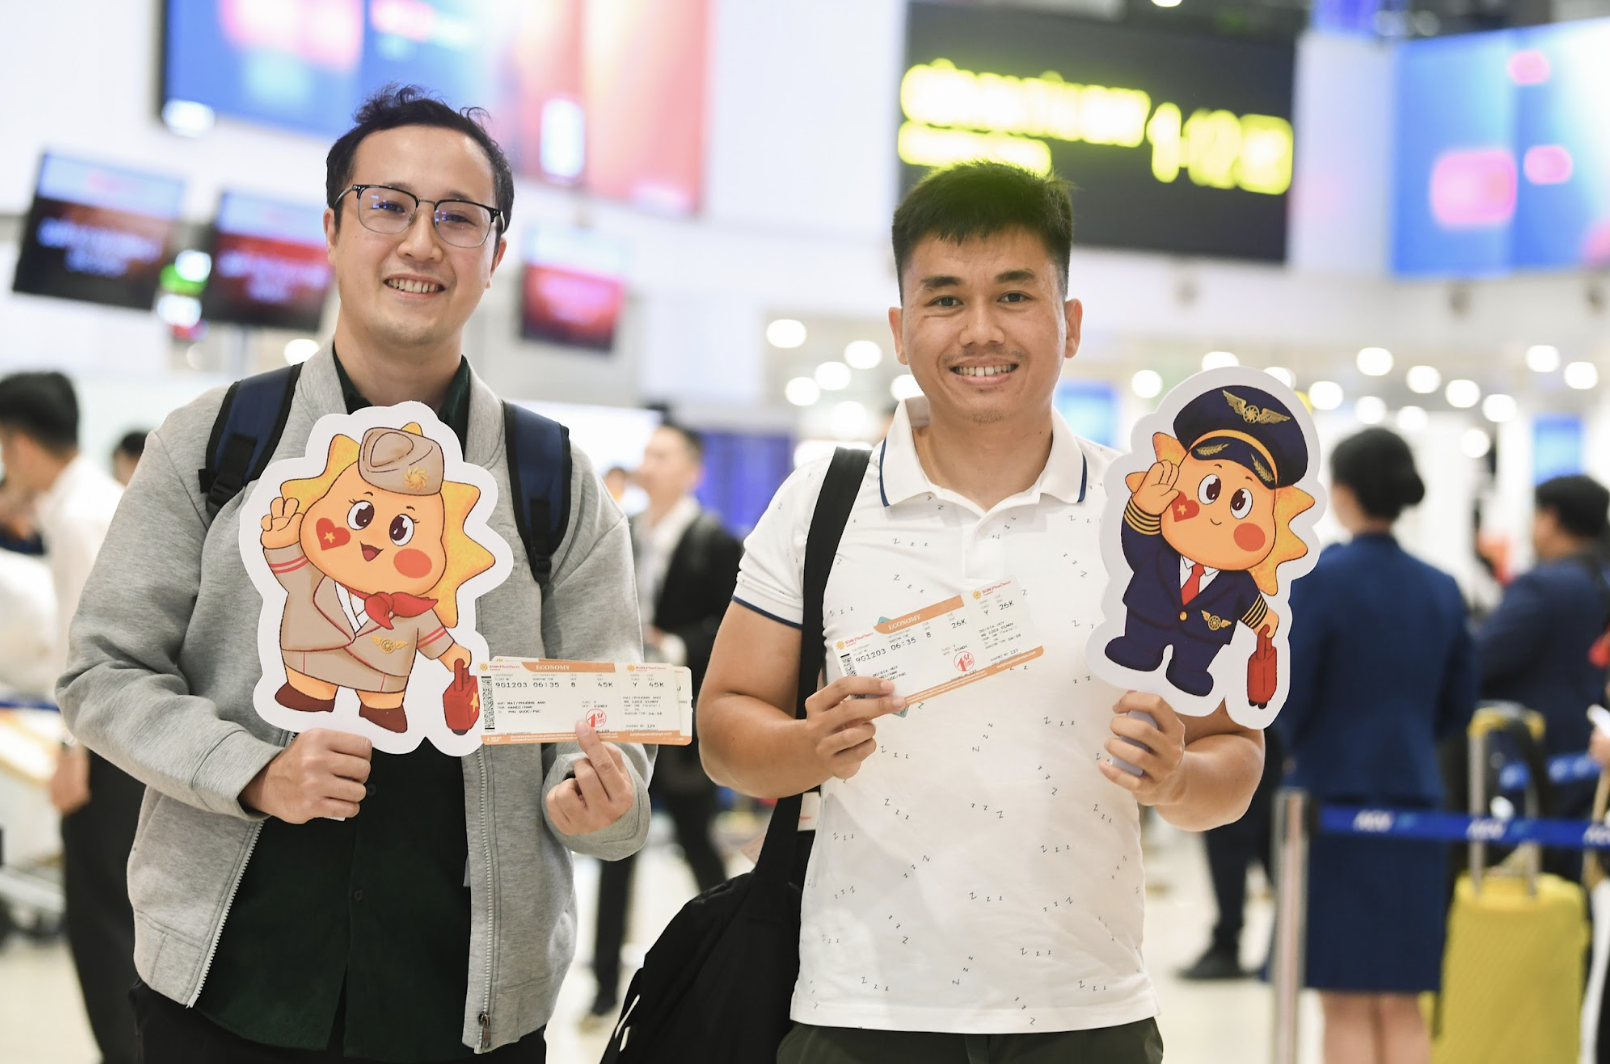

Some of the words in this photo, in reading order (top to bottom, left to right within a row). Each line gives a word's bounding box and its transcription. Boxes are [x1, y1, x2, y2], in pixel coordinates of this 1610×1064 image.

[999, 600, 1014, 611] 26K
[888, 614, 921, 631] ECONOMY
[951, 618, 966, 629] 26K
[890, 637, 917, 651] 06:35
